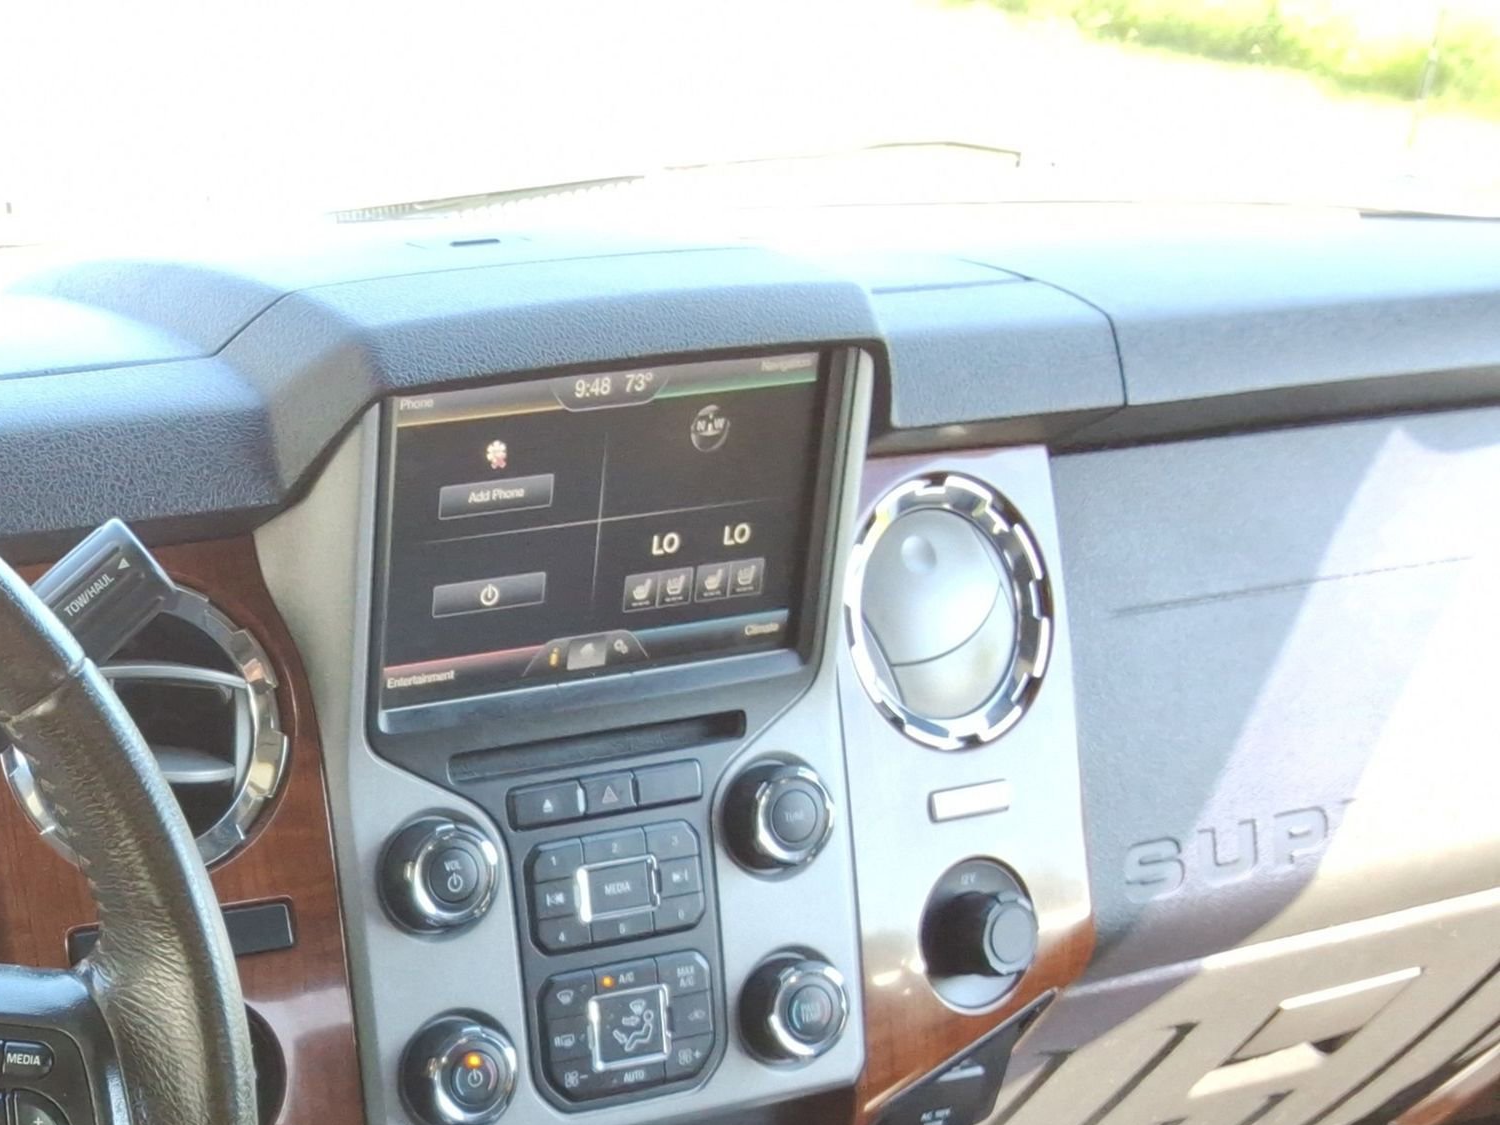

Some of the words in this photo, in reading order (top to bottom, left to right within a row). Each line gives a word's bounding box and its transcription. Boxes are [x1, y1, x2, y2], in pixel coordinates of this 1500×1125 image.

[574, 377, 611, 398] 9:48
[399, 396, 434, 411] Phone
[467, 488, 490, 503] Add
[493, 484, 525, 502] Phone
[723, 522, 751, 546] LO
[651, 532, 681, 556] LO
[63, 572, 116, 619] TOW/HAUL
[744, 620, 780, 638] Climate
[387, 668, 456, 689] Entertainment
[611, 842, 619, 853] 2
[671, 836, 679, 846] 3
[444, 858, 463, 873] VOL
[551, 856, 557, 866] 1
[604, 880, 632, 896] MEDIA
[558, 931, 566, 942] 4
[619, 971, 635, 984] A/C
[6, 1053, 41, 1066] MEDIA
[623, 1069, 646, 1083] AUTO
